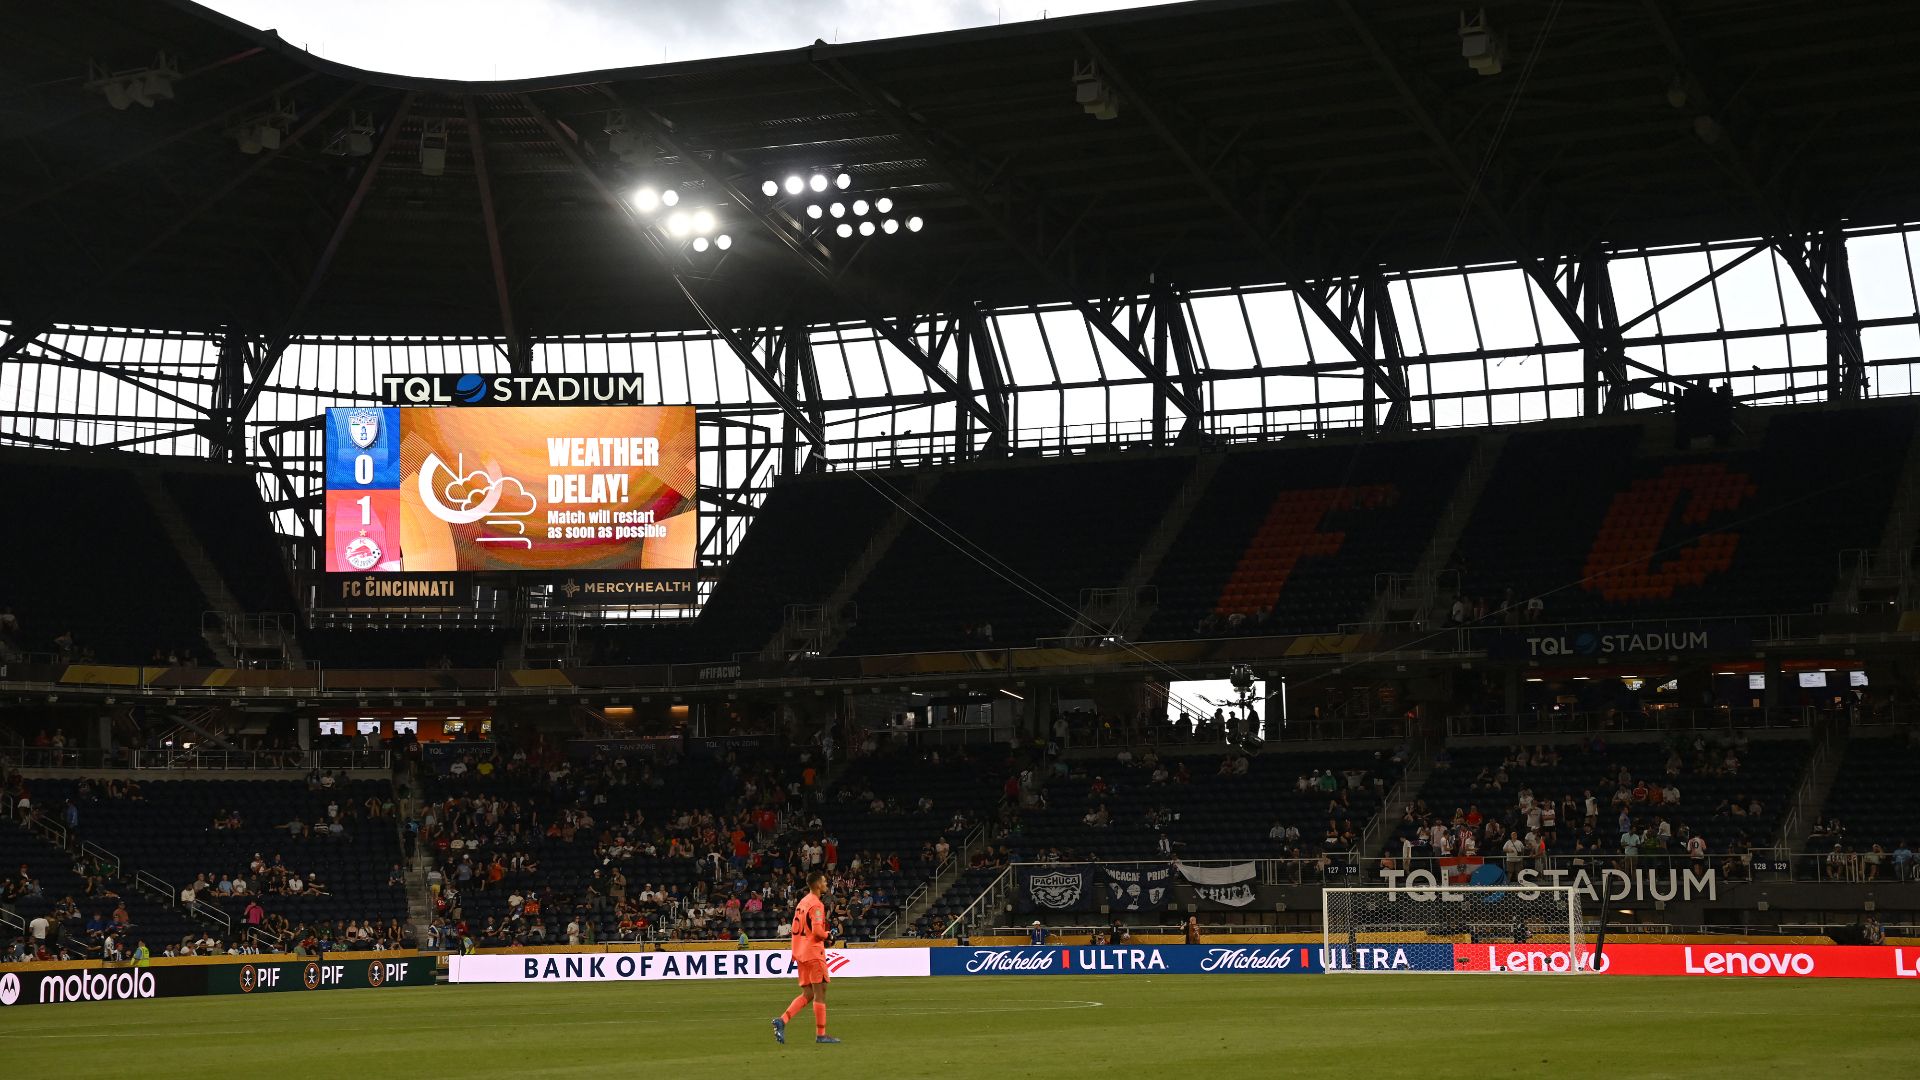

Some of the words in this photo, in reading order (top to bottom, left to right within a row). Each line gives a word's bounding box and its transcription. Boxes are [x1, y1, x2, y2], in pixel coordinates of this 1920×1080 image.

[384, 377, 452, 403] TQL
[493, 377, 643, 402] STADIUM
[547, 437, 659, 467] WEATHER
[355, 454, 374, 485] 0
[547, 474, 629, 504] DELAY!
[356, 495, 371, 525] 1
[547, 510, 585, 525] Match
[588, 509, 610, 524] will
[613, 509, 655, 524] restart
[547, 527, 563, 539] as
[565, 527, 594, 539] soon
[597, 527, 613, 539] as
[615, 524, 667, 540] possible
[342, 580, 361, 599] FC
[365, 579, 454, 597] CINCINNATI
[584, 581, 691, 594] MERCYHEALTH
[1527, 637, 1574, 657] TQL
[1600, 632, 1709, 654] STADIUM
[699, 665, 741, 680] #FIFACWC
[1035, 876, 1080, 886] PACHUCA
[1147, 868, 1169, 882] PRIDE
[1327, 866, 1339, 874] 127
[1345, 866, 1357, 874] 128
[1380, 869, 1465, 902] TQL
[1517, 868, 1718, 902] STADIUM
[386, 962, 409, 982] PIF
[525, 956, 607, 979] BANK
[616, 954, 653, 978] OF
[966, 949, 1058, 973] Michelob
[1080, 949, 1168, 970] ULTRA
[1201, 949, 1294, 972] Michelob
[1319, 948, 1409, 970] ULTRA
[1489, 946, 1610, 974] Lenovo
[1685, 947, 1815, 975] Lenovo
[39, 967, 156, 1004] motorola
[258, 967, 281, 987] PIF
[321, 965, 345, 984] PIF
